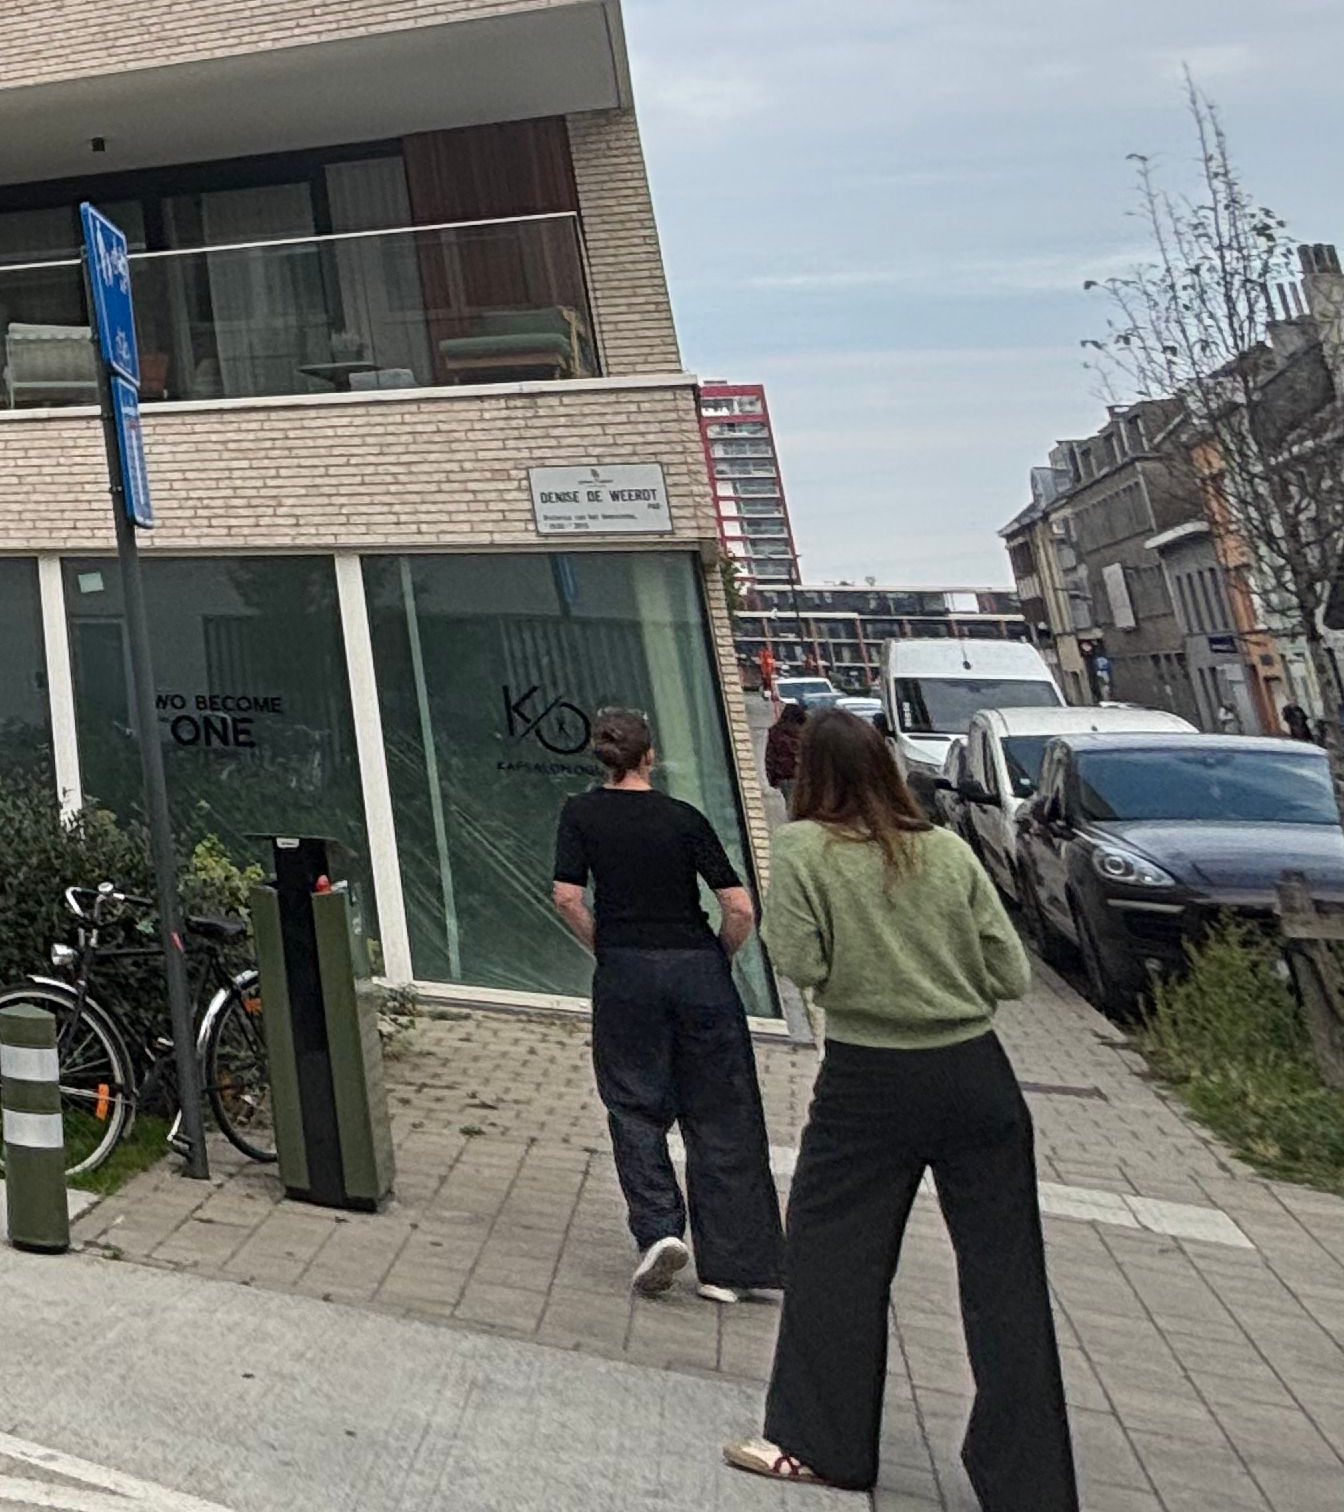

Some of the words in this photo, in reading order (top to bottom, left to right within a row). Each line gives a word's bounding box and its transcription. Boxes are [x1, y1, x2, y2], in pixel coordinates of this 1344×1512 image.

[540, 491, 580, 504] DENISE
[586, 490, 603, 502] DE
[608, 488, 657, 502] WEERDT
[155, 693, 186, 710] WO
[195, 694, 283, 713] BECOME
[170, 714, 256, 748] ONE
